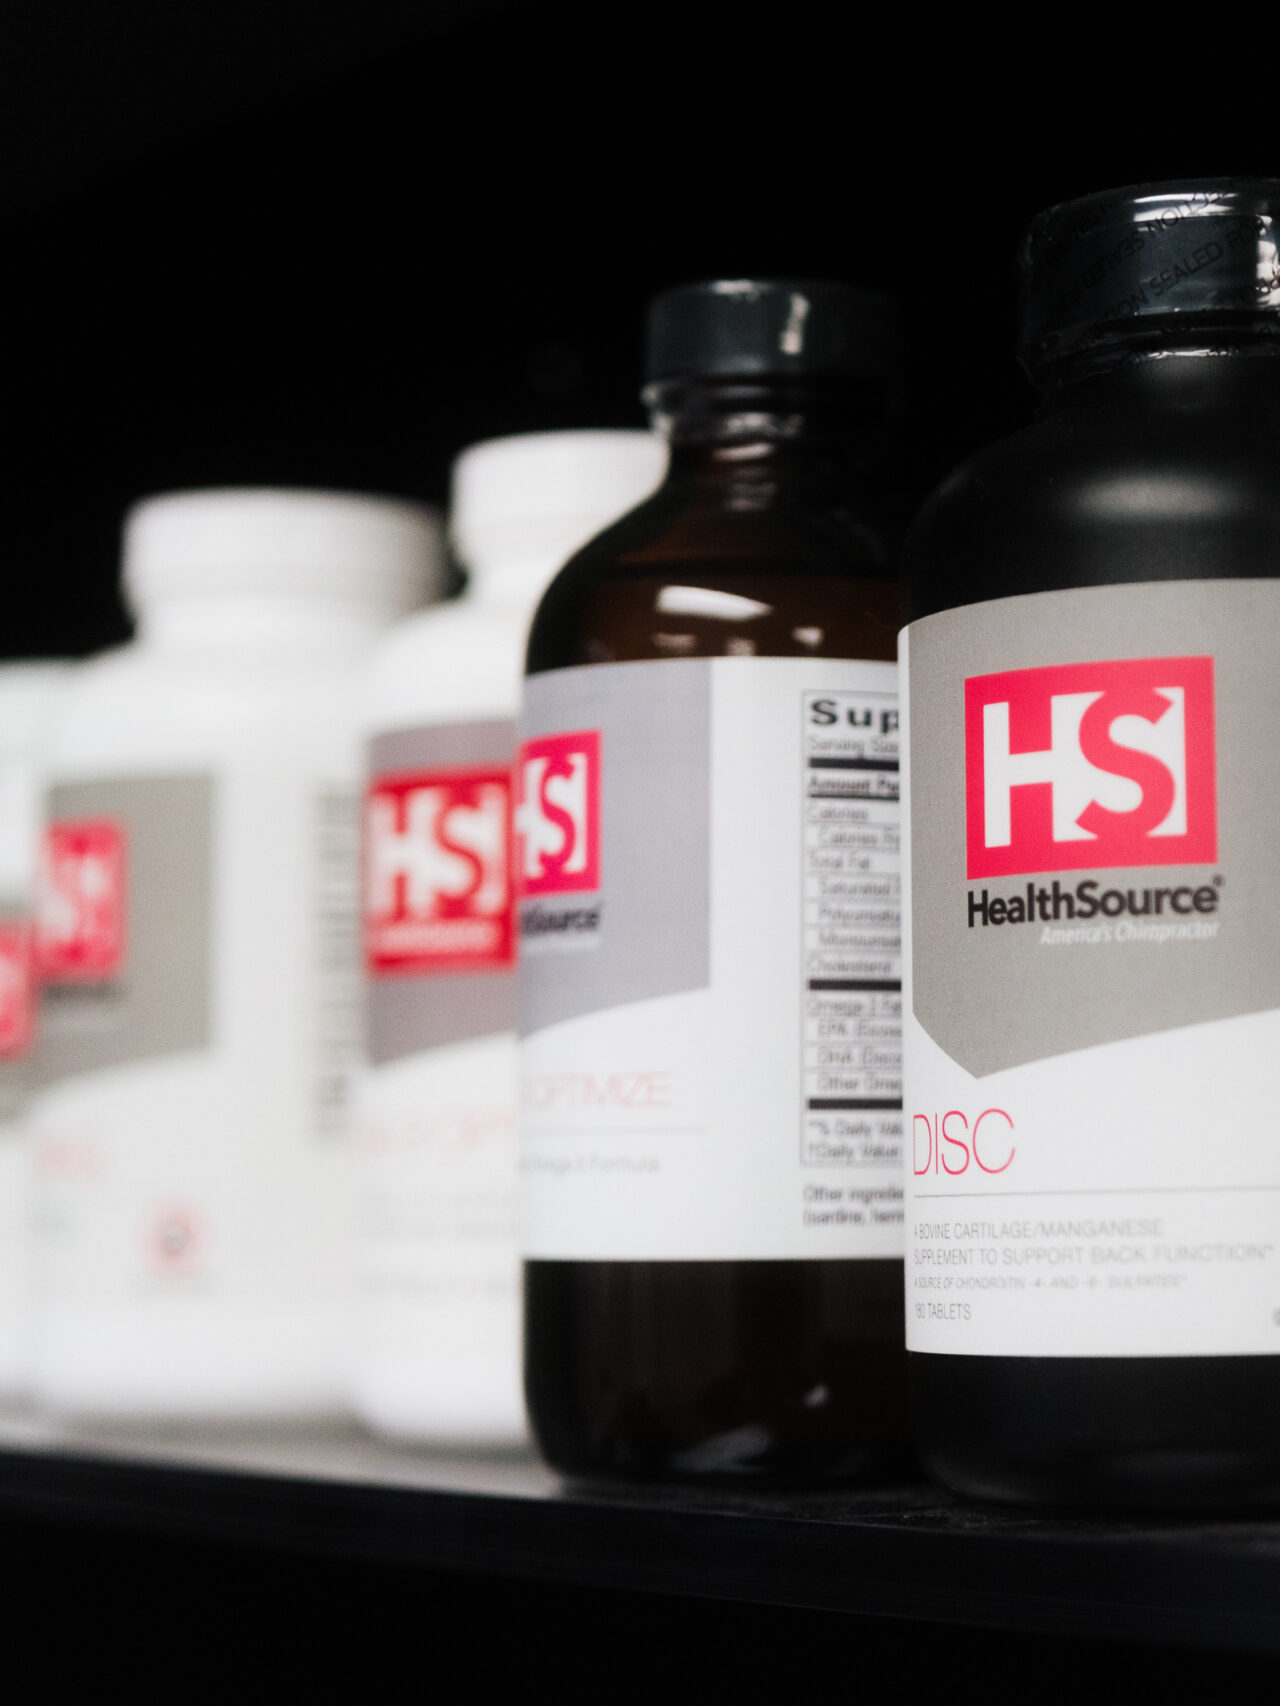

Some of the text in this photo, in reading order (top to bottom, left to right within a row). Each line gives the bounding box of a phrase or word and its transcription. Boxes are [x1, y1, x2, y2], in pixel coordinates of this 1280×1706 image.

[1150, 241, 1224, 297] SEALED
[982, 686, 1188, 848] HS
[366, 781, 507, 917] HS
[912, 1108, 1016, 1176] DISC
[919, 1222, 951, 1240] BOVINE
[953, 1218, 1164, 1240] CARTILAGE/MANGANESE
[914, 1247, 975, 1266] SUPPLEMENT
[979, 1248, 998, 1265] TO
[1002, 1246, 1085, 1266] SUPPORT
[1090, 1244, 1147, 1264] BACK
[918, 1276, 942, 1289] SOURCE
[943, 1276, 954, 1289] OF
[1049, 1276, 1079, 1289] AND
[927, 1303, 972, 1320] TABLETS
